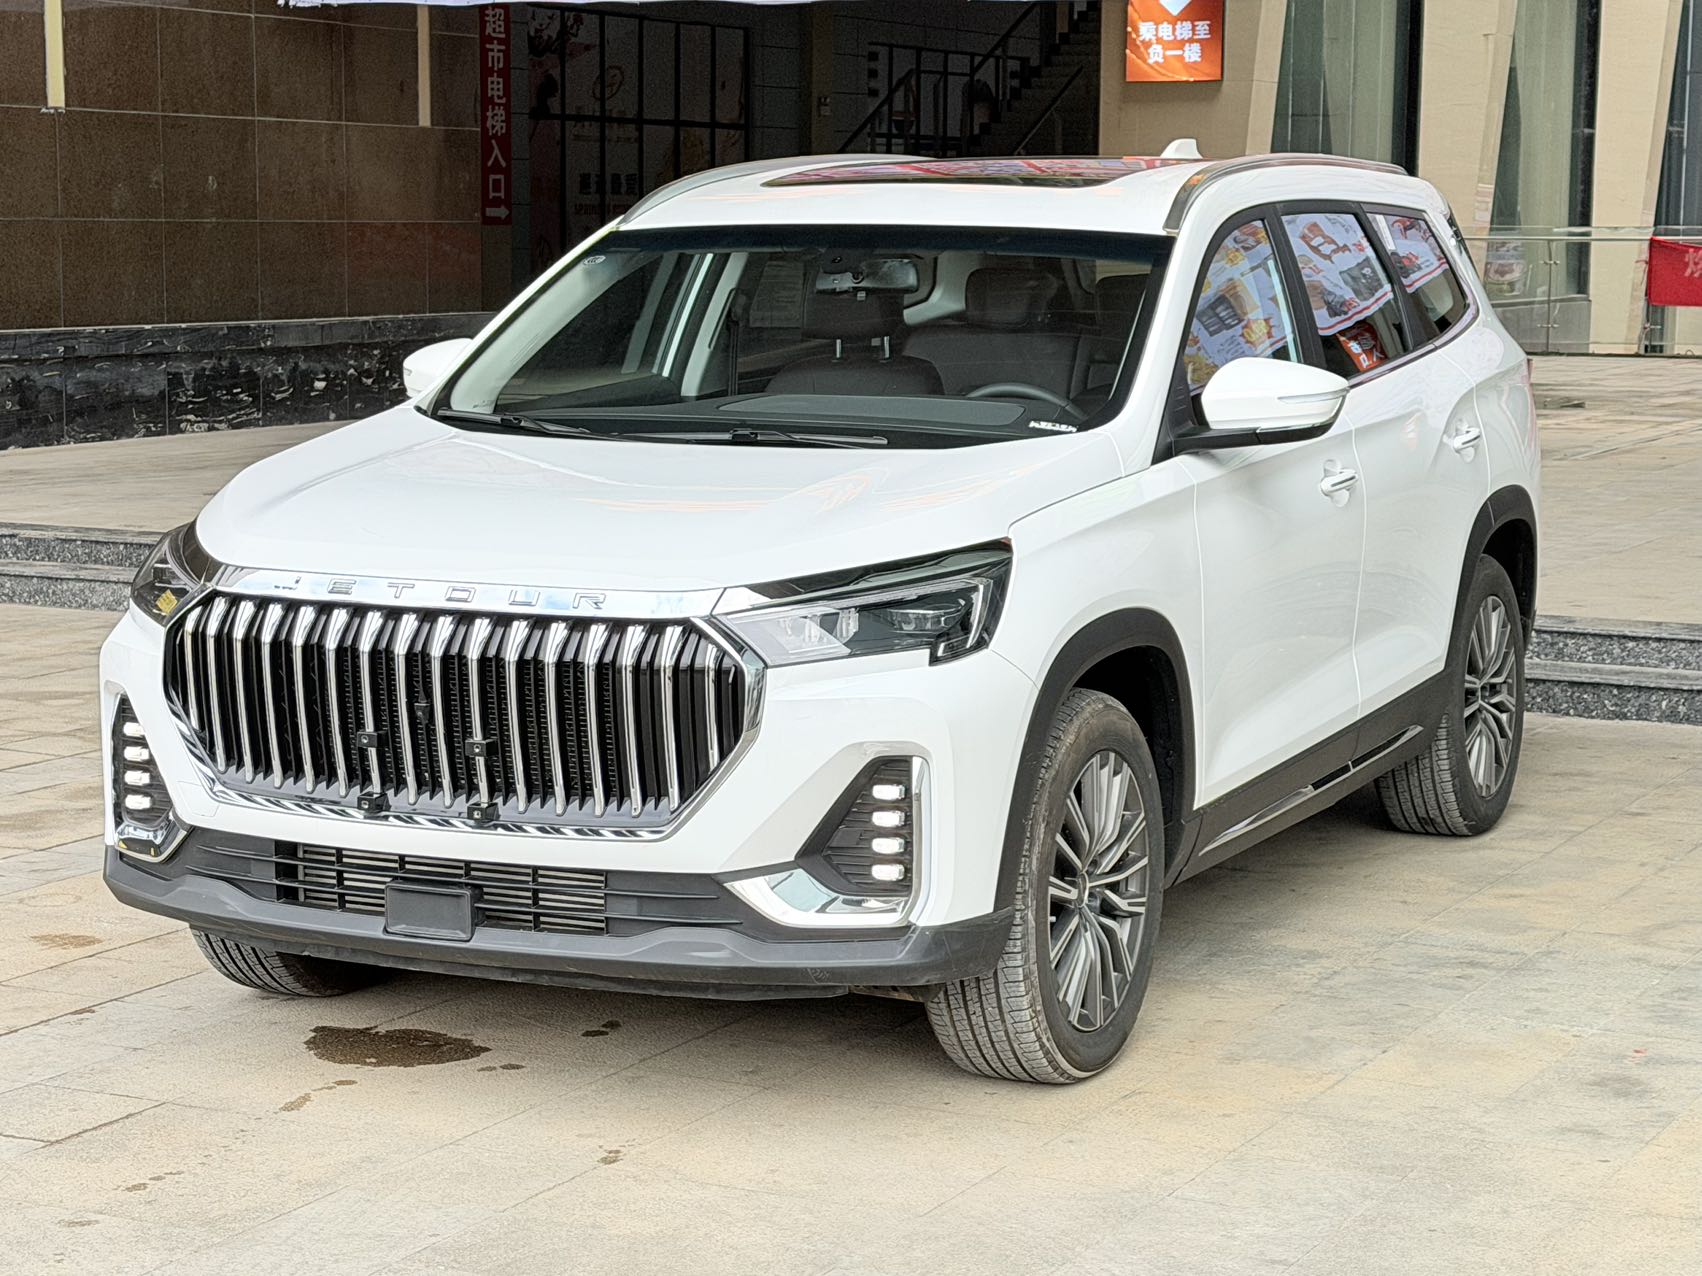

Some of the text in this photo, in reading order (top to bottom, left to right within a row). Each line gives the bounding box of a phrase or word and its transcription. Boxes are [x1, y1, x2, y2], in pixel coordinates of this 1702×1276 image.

[1138, 21, 1211, 41] 乘电梯至
[1147, 43, 1202, 64] 负一楼
[484, 6, 507, 200] 超市电梯入口
[273, 576, 607, 610] JETOUR
